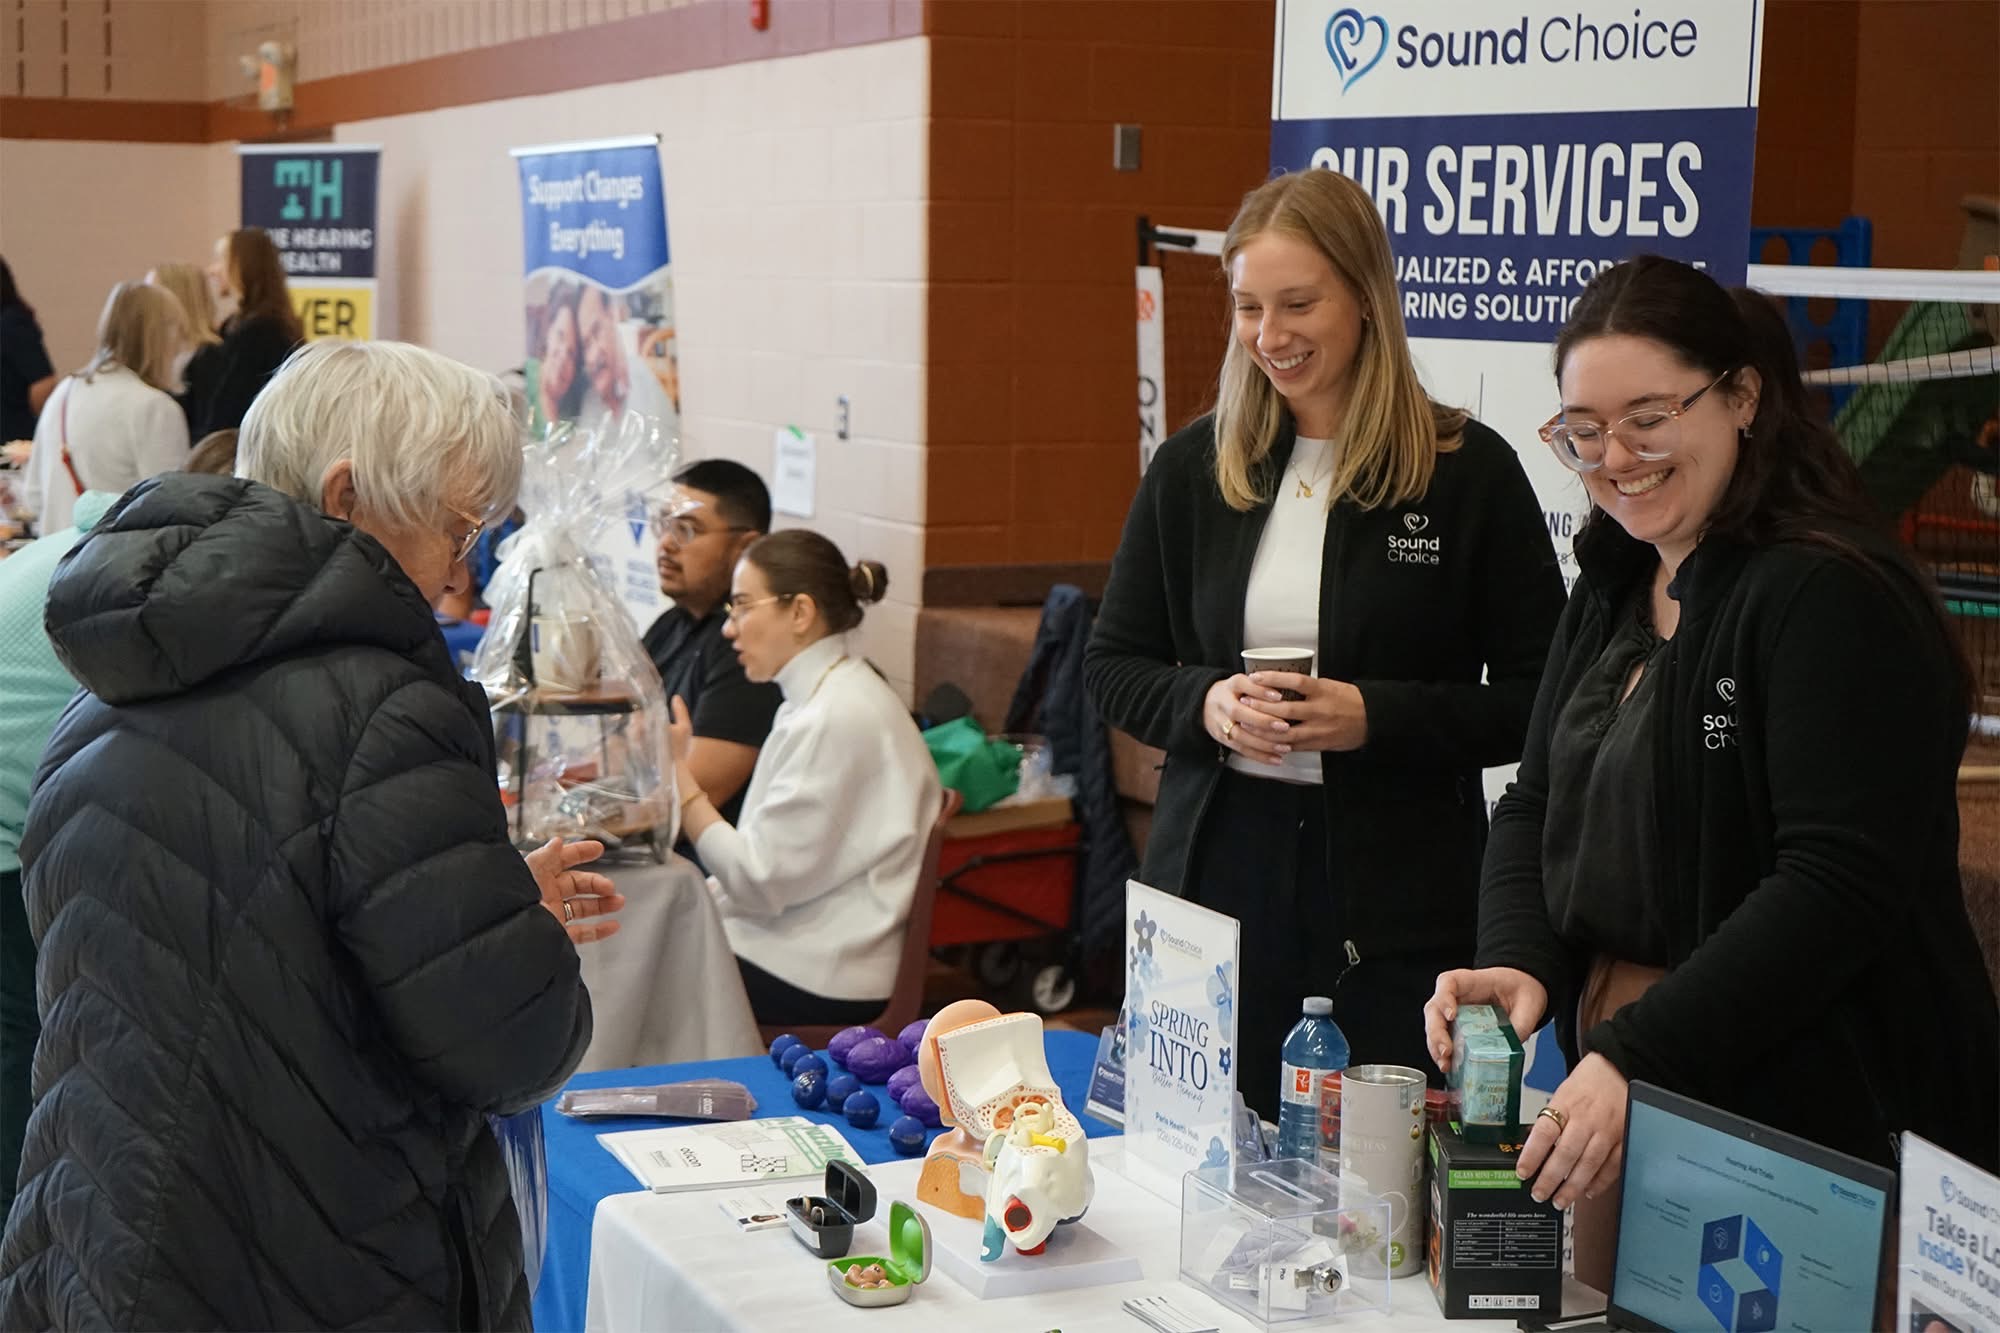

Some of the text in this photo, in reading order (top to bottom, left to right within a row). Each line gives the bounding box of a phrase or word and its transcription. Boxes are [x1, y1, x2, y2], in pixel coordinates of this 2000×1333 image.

[1396, 9, 1698, 69] Sound Choice
[528, 170, 643, 211] Support Changes
[1423, 141, 1703, 238] SERVICES
[291, 228, 373, 249] HEARING
[549, 219, 624, 260] Everything
[1497, 258, 1518, 286] &
[1388, 535, 1439, 551] Sound
[1388, 549, 1440, 565] Choice
[1150, 1000, 1209, 1048] SPRING
[1149, 1029, 1208, 1091] INTO
[1925, 1205, 1967, 1248] Take
[1969, 1233, 1980, 1255] a
[1918, 1232, 1964, 1275] Inside
